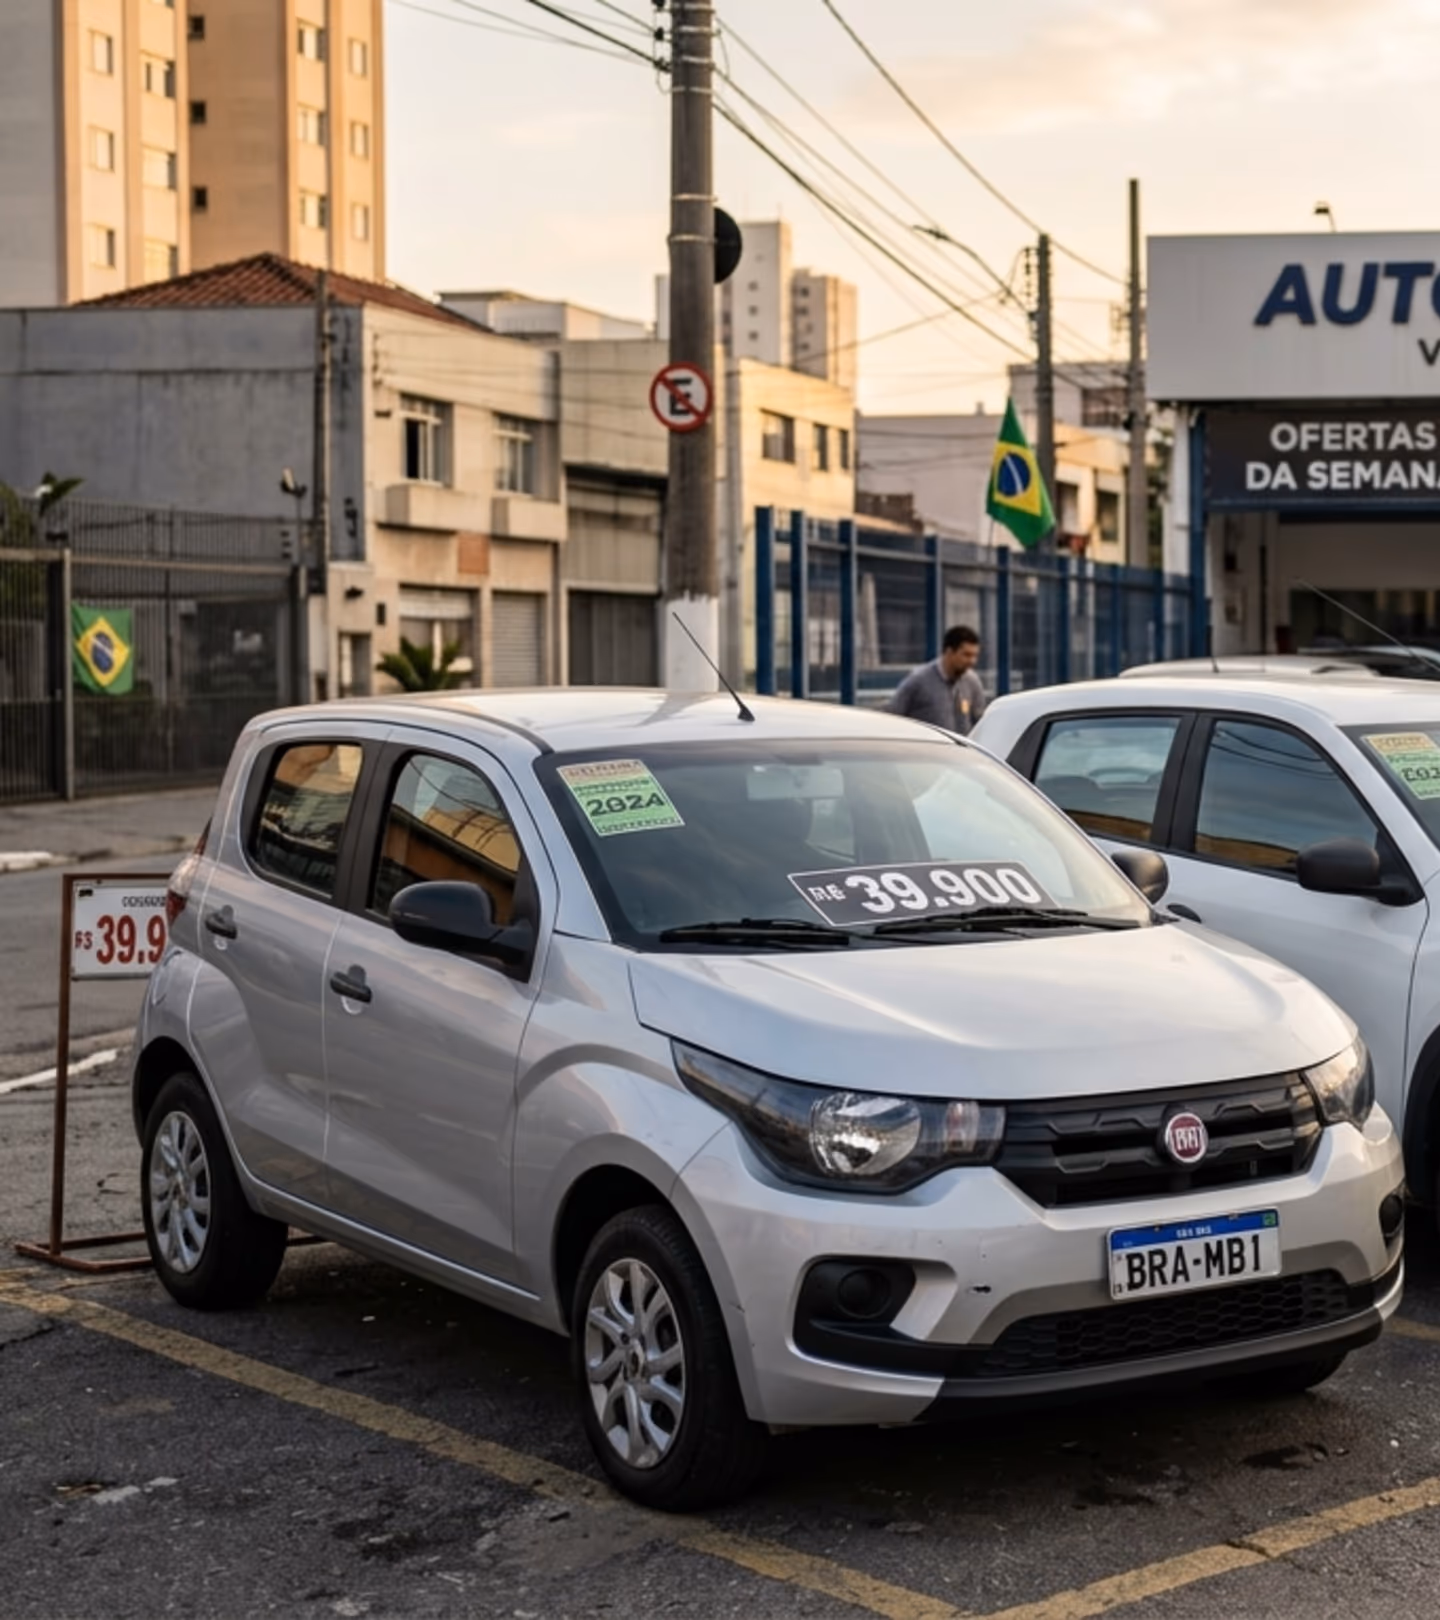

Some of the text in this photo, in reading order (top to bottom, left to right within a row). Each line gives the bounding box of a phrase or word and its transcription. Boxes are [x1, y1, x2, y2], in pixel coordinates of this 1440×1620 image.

[1270, 421, 1437, 452] OFERTAS
[1246, 463, 1296, 490] DA
[845, 868, 1042, 913] 39.900
[1126, 1234, 1261, 1291] BRA-MB1
